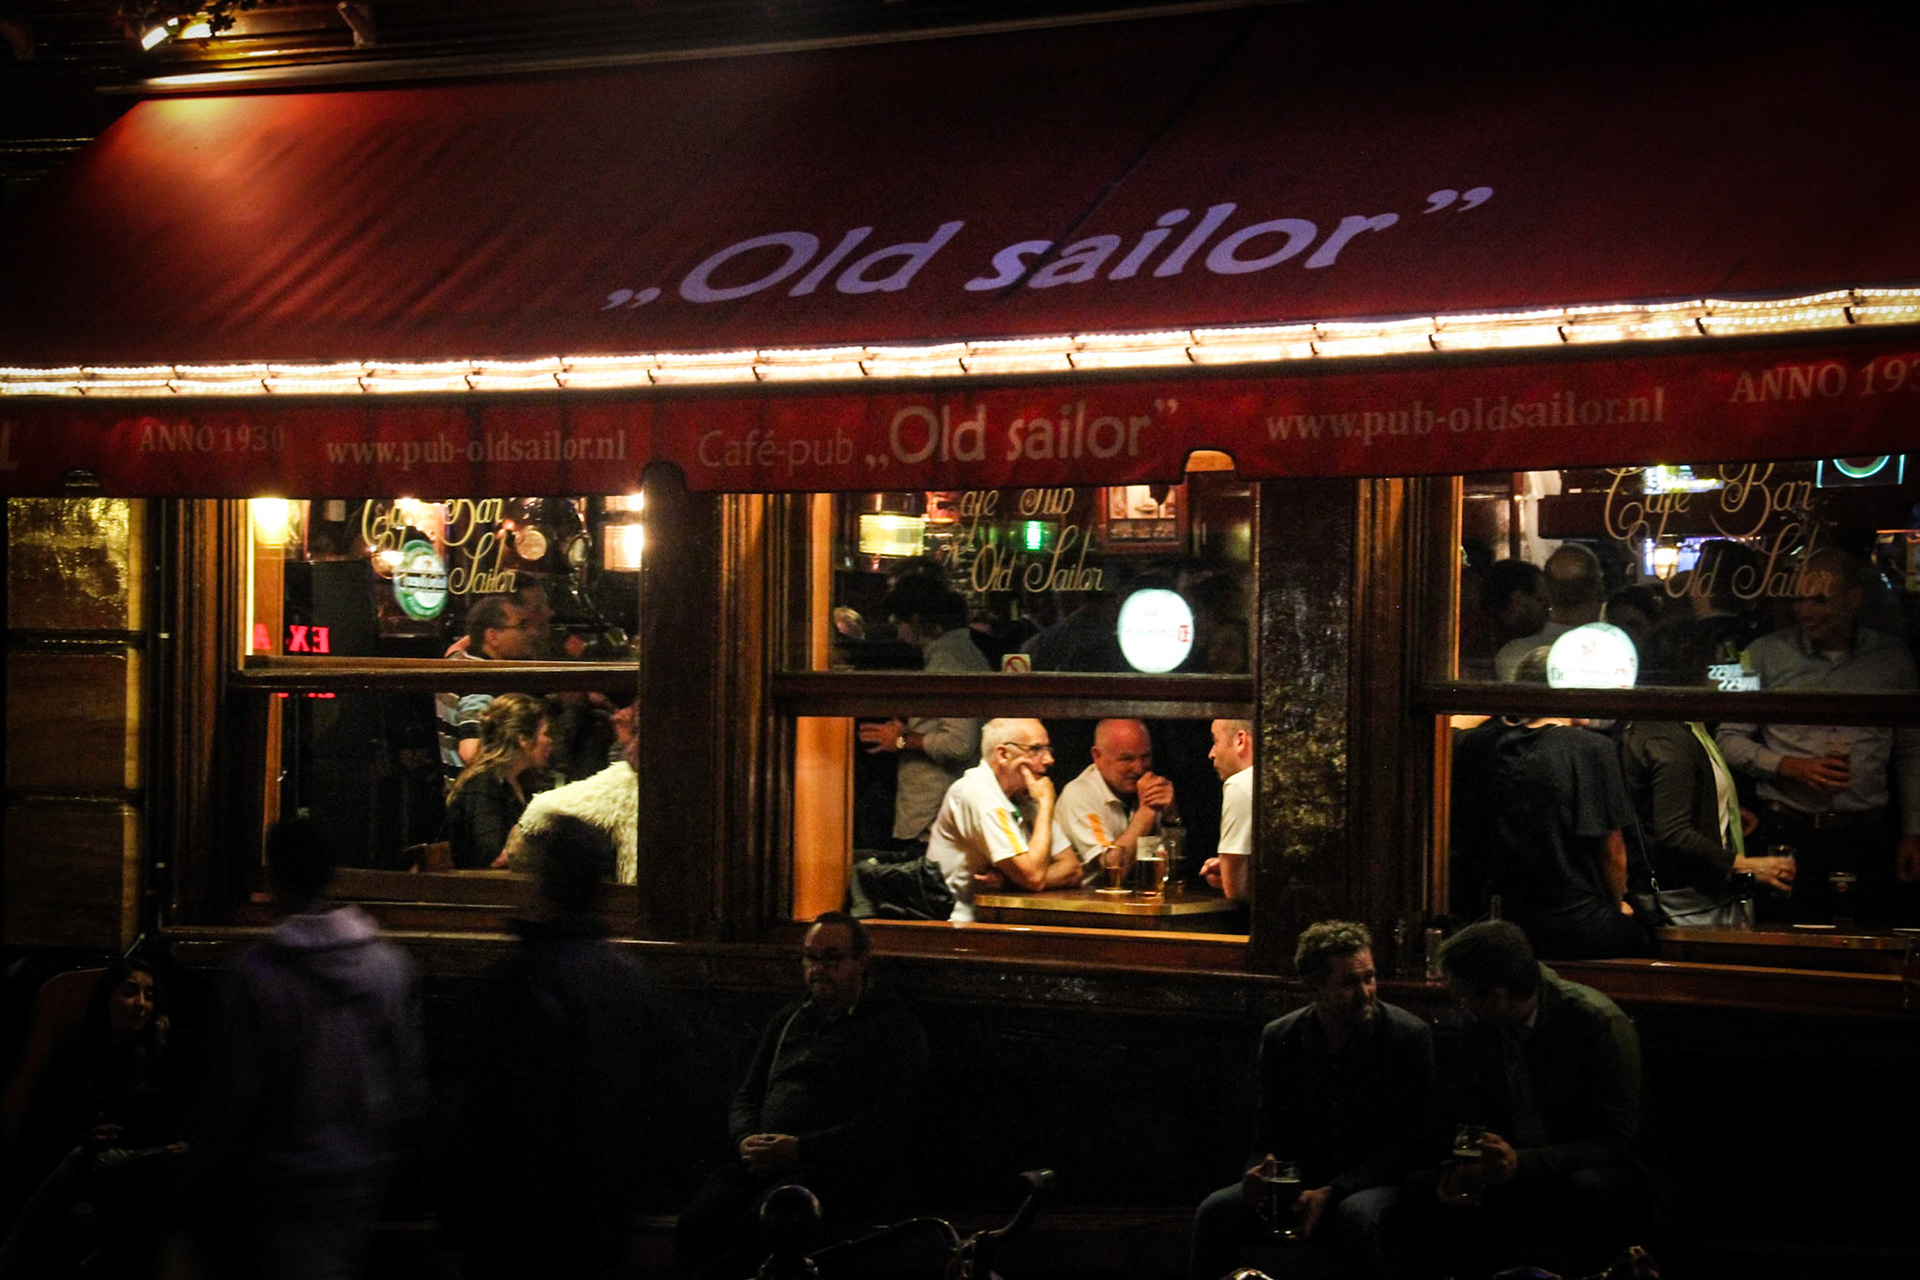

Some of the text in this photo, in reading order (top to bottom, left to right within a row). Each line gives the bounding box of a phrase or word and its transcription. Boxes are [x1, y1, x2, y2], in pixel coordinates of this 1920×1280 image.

[1731, 362, 1847, 403] ANNO
[1266, 386, 1665, 445] www.pub-oldsailor.nl
[138, 425, 285, 451] ANNO 1930
[326, 430, 626, 470] www.pub-oldsailor.nl
[699, 430, 854, 471] Café-pub
[449, 531, 518, 595] Sailor
[1023, 525, 1104, 593] Sailor
